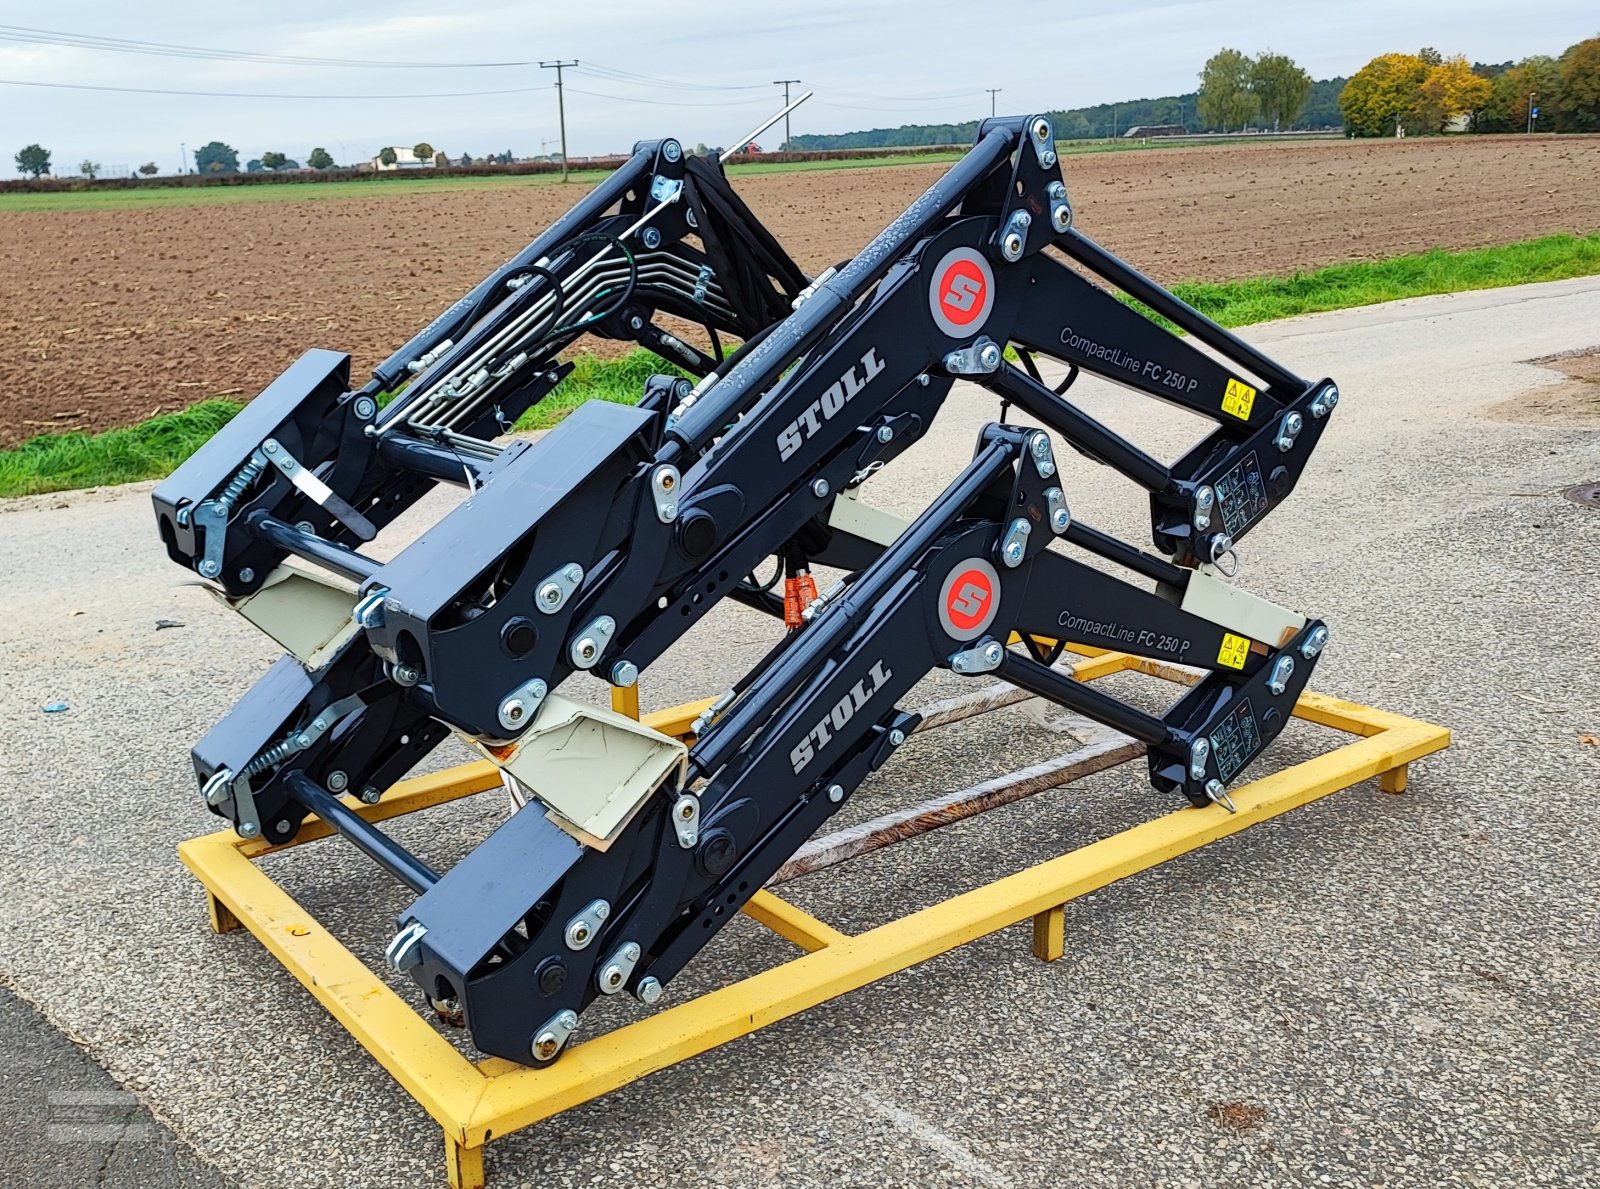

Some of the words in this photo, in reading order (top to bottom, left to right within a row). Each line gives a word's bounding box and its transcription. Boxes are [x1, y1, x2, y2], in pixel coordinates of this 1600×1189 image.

[943, 274, 982, 311] S
[1060, 327, 1140, 372] CompactLine
[1142, 361, 1162, 380] FC
[1163, 369, 1186, 390] 250
[1187, 379, 1198, 393] P
[776, 346, 886, 463] STOLL
[951, 583, 989, 617] S
[1058, 610, 1135, 643] CompactLine
[1136, 631, 1156, 647] FC
[1157, 636, 1179, 652] 250
[1180, 640, 1191, 654] P
[789, 659, 893, 775] STOLL
